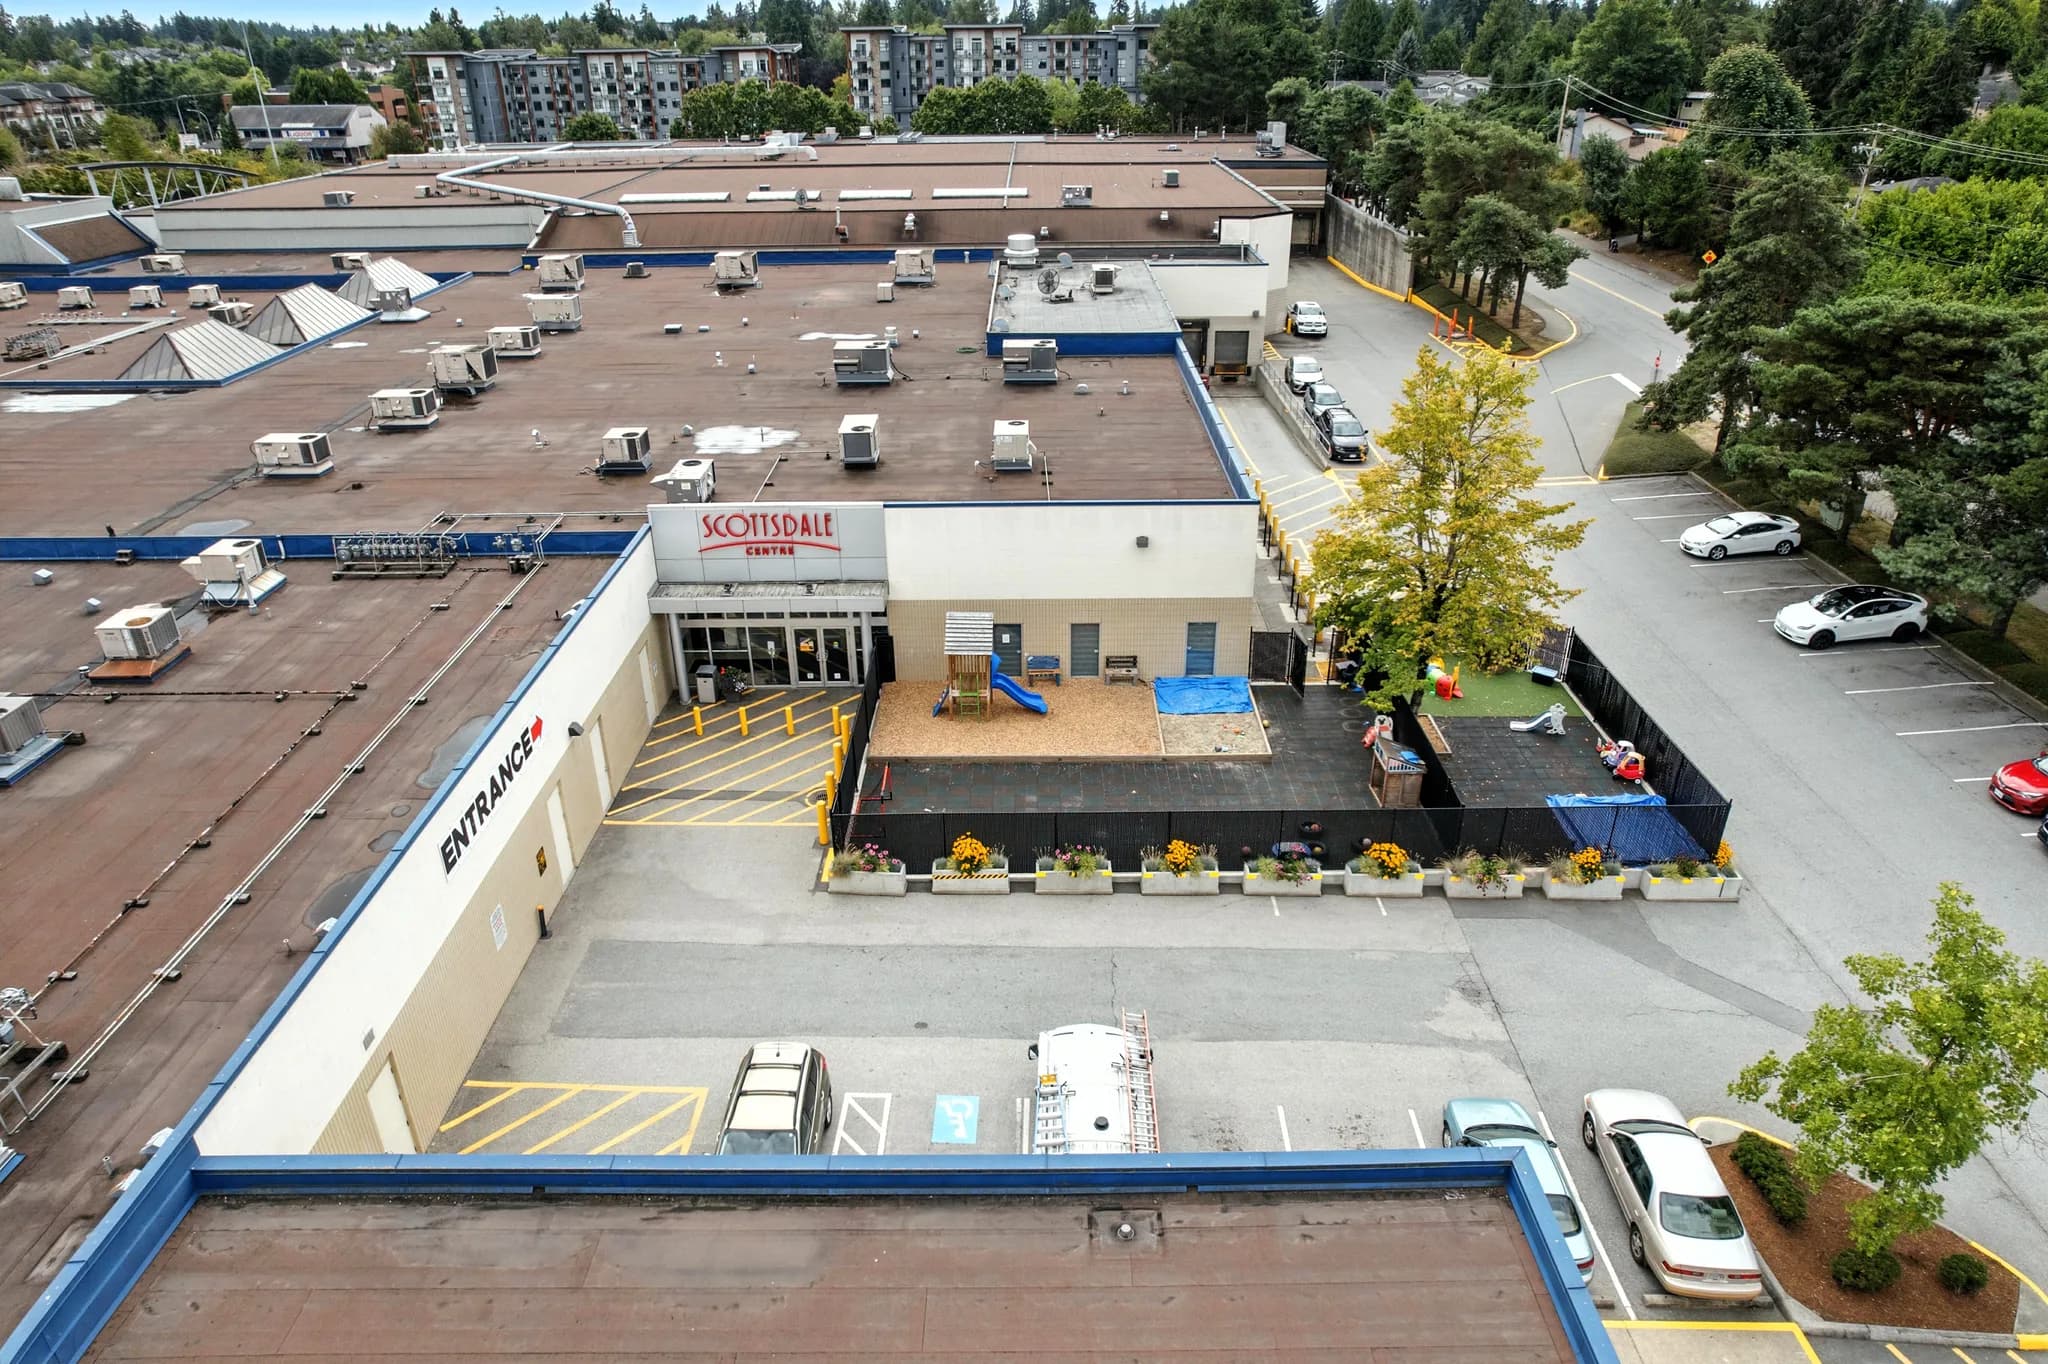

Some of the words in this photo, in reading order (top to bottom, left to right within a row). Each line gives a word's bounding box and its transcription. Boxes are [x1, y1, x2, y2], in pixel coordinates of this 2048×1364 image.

[702, 512, 833, 538] SCOTTSDALE
[745, 545, 796, 556] CENTRE
[440, 726, 533, 876] ENTRANCE
